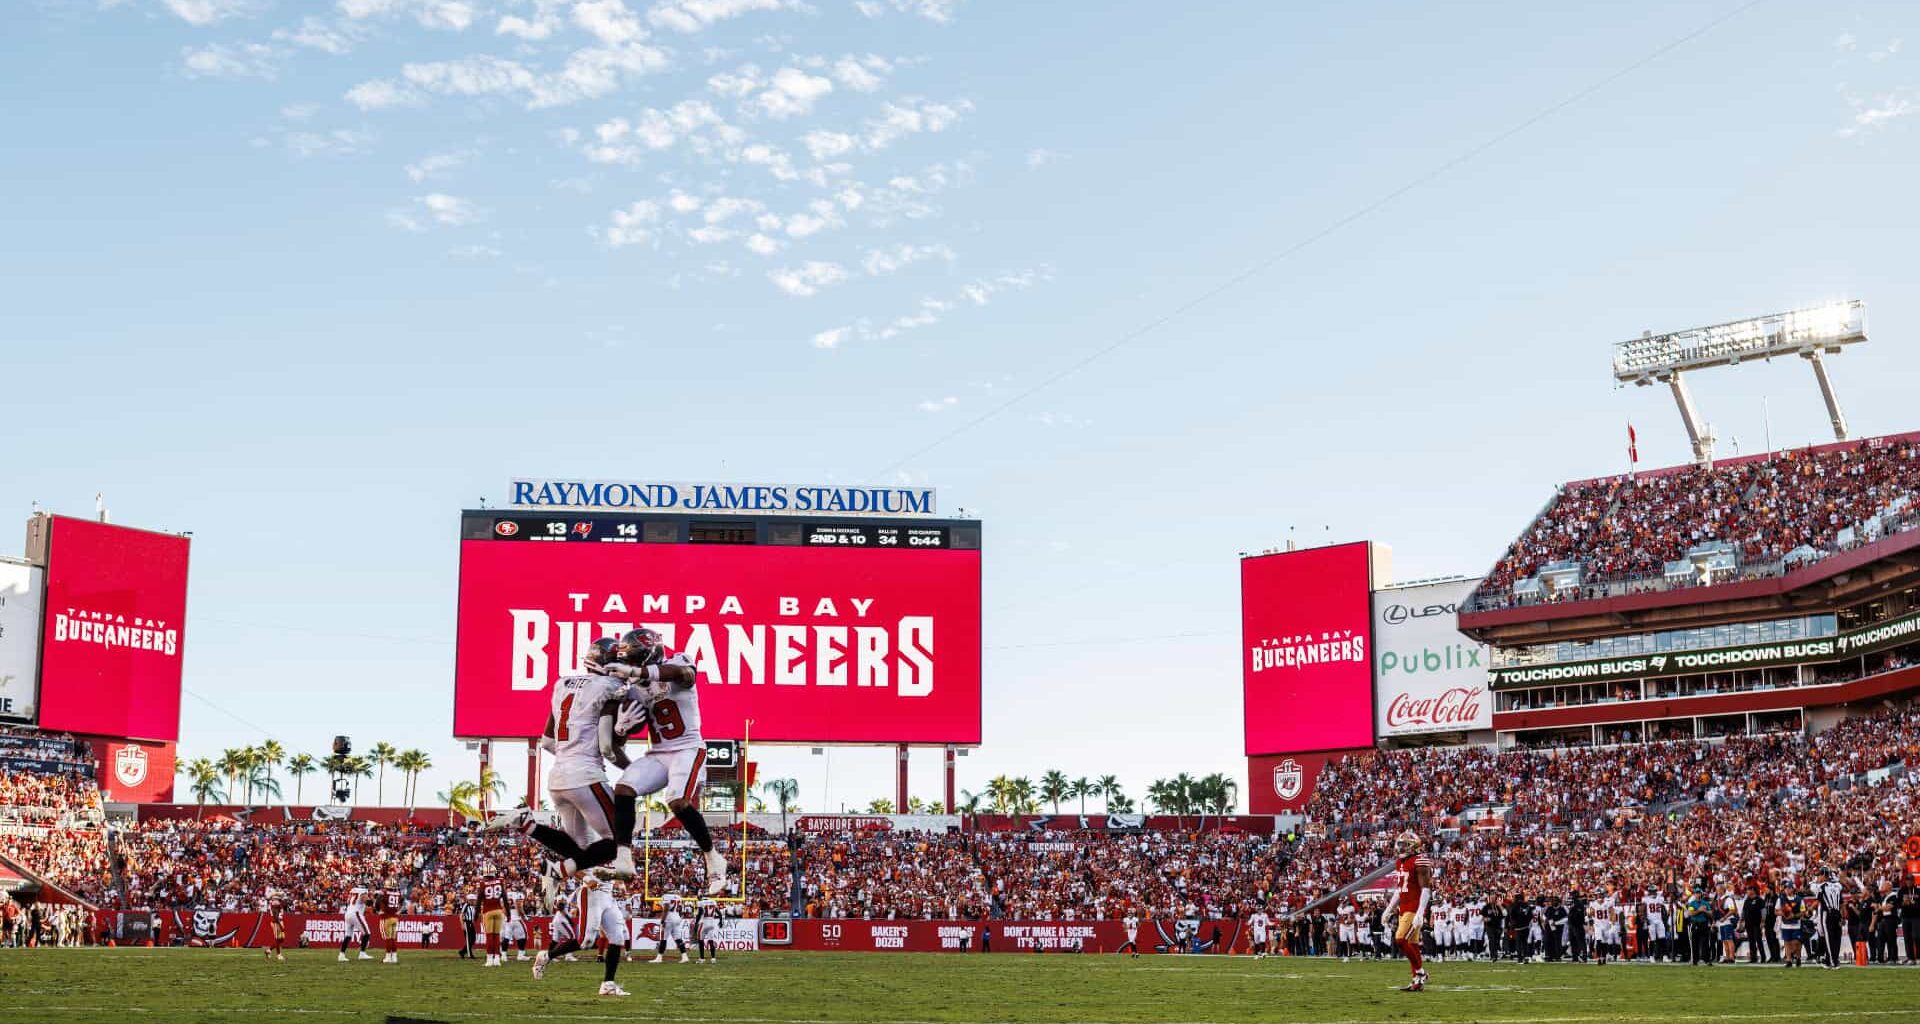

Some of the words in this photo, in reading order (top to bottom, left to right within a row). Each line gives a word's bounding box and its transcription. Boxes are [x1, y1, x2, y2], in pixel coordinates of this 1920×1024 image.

[513, 481, 678, 507] RAYMOND
[683, 485, 788, 510] JAMES
[795, 487, 932, 514] STADIUM
[546, 522, 567, 535] 13
[616, 523, 639, 536] 14
[810, 534, 837, 544] 2ND
[838, 534, 849, 544] &
[850, 535, 866, 545] 10
[879, 535, 898, 545] 34
[908, 536, 941, 546] 0:44
[569, 593, 744, 614] TAMPA
[780, 596, 874, 617] BAY
[67, 608, 125, 623] TAMPA
[135, 618, 166, 628] BAY
[55, 613, 177, 656] BUCCANEERS
[1261, 633, 1312, 646] TAMPA
[1322, 629, 1352, 640] BAY
[1849, 618, 1916, 649] TOUCHDOWN
[1251, 635, 1364, 673] BUCCANEERS
[1381, 643, 1481, 677] Publix
[1675, 646, 1781, 668] TOUCHDOWN
[1784, 641, 1834, 658] BUCS!
[1501, 664, 1598, 684] TOUCHDOWN
[1601, 659, 1647, 675] BUCS!
[1386, 686, 1484, 728] Coca-Cola
[557, 691, 577, 742] 1
[707, 747, 730, 759] 36
[485, 885, 502, 900] 98
[305, 919, 346, 931] BREDESO
[822, 924, 841, 938] 50
[871, 926, 908, 938] BAKER'S
[1003, 926, 1031, 937] DON'T
[1032, 926, 1057, 937] MAKE
[1058, 926, 1065, 937] A
[1066, 926, 1097, 939] SCENE,
[875, 937, 904, 948] DOZEN
[1017, 937, 1035, 948] IT'S
